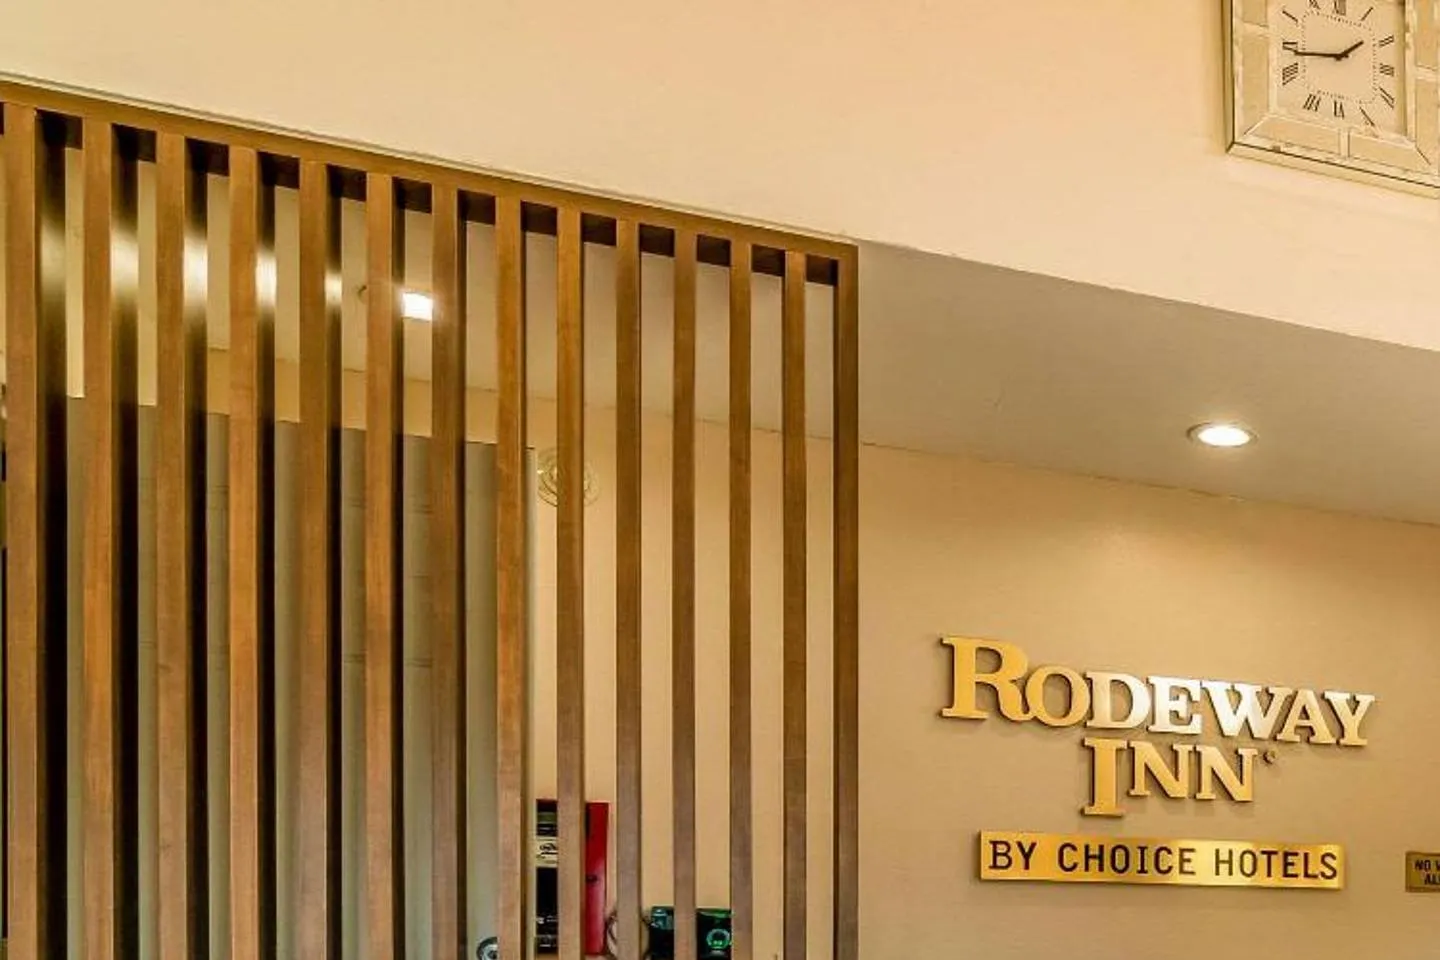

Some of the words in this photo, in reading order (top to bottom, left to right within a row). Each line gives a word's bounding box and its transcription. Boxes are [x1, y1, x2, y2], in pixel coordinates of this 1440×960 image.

[941, 635, 1376, 747] RODEWAY
[1080, 736, 1259, 817] INN
[988, 840, 1038, 871] BY
[1057, 843, 1197, 876] CHOICE
[1213, 848, 1339, 881] HOTELS
[1414, 859, 1432, 872] NO
